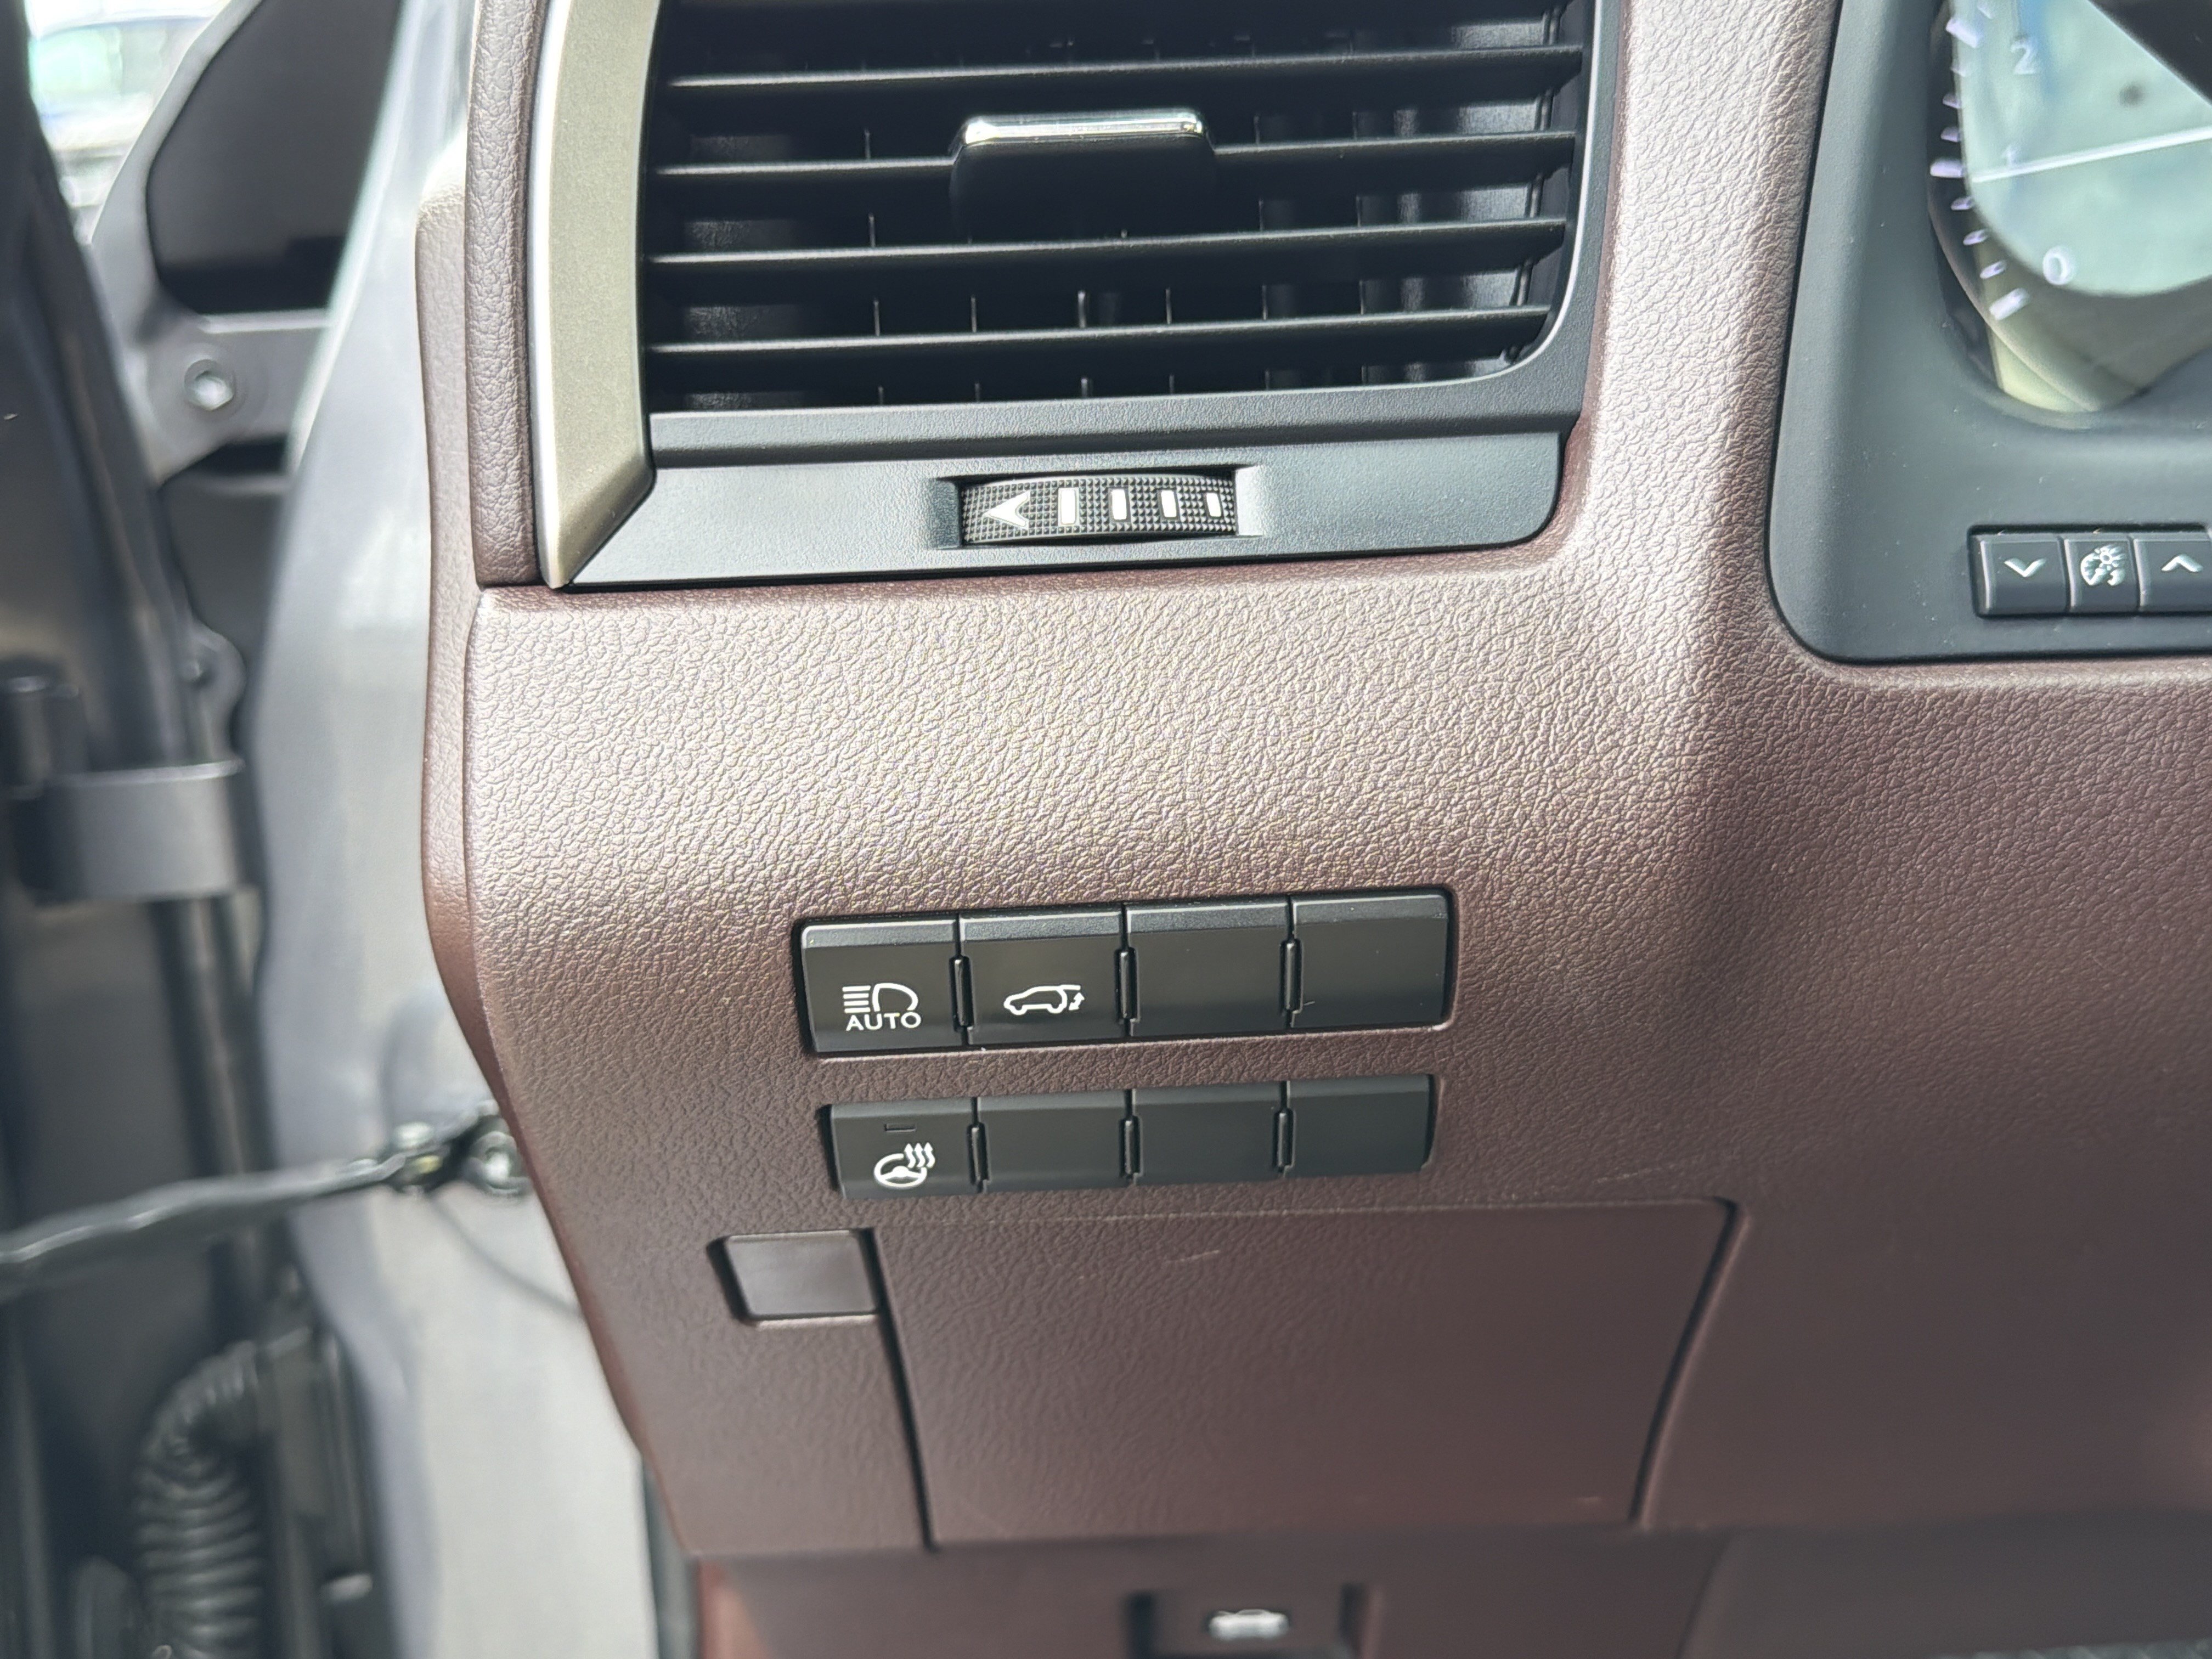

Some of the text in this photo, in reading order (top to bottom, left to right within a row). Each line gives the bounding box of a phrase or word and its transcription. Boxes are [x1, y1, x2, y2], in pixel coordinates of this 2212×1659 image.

[2010, 40, 2037, 75] 2
[2042, 246, 2072, 285] 0
[845, 1011, 922, 1032] AUTO
